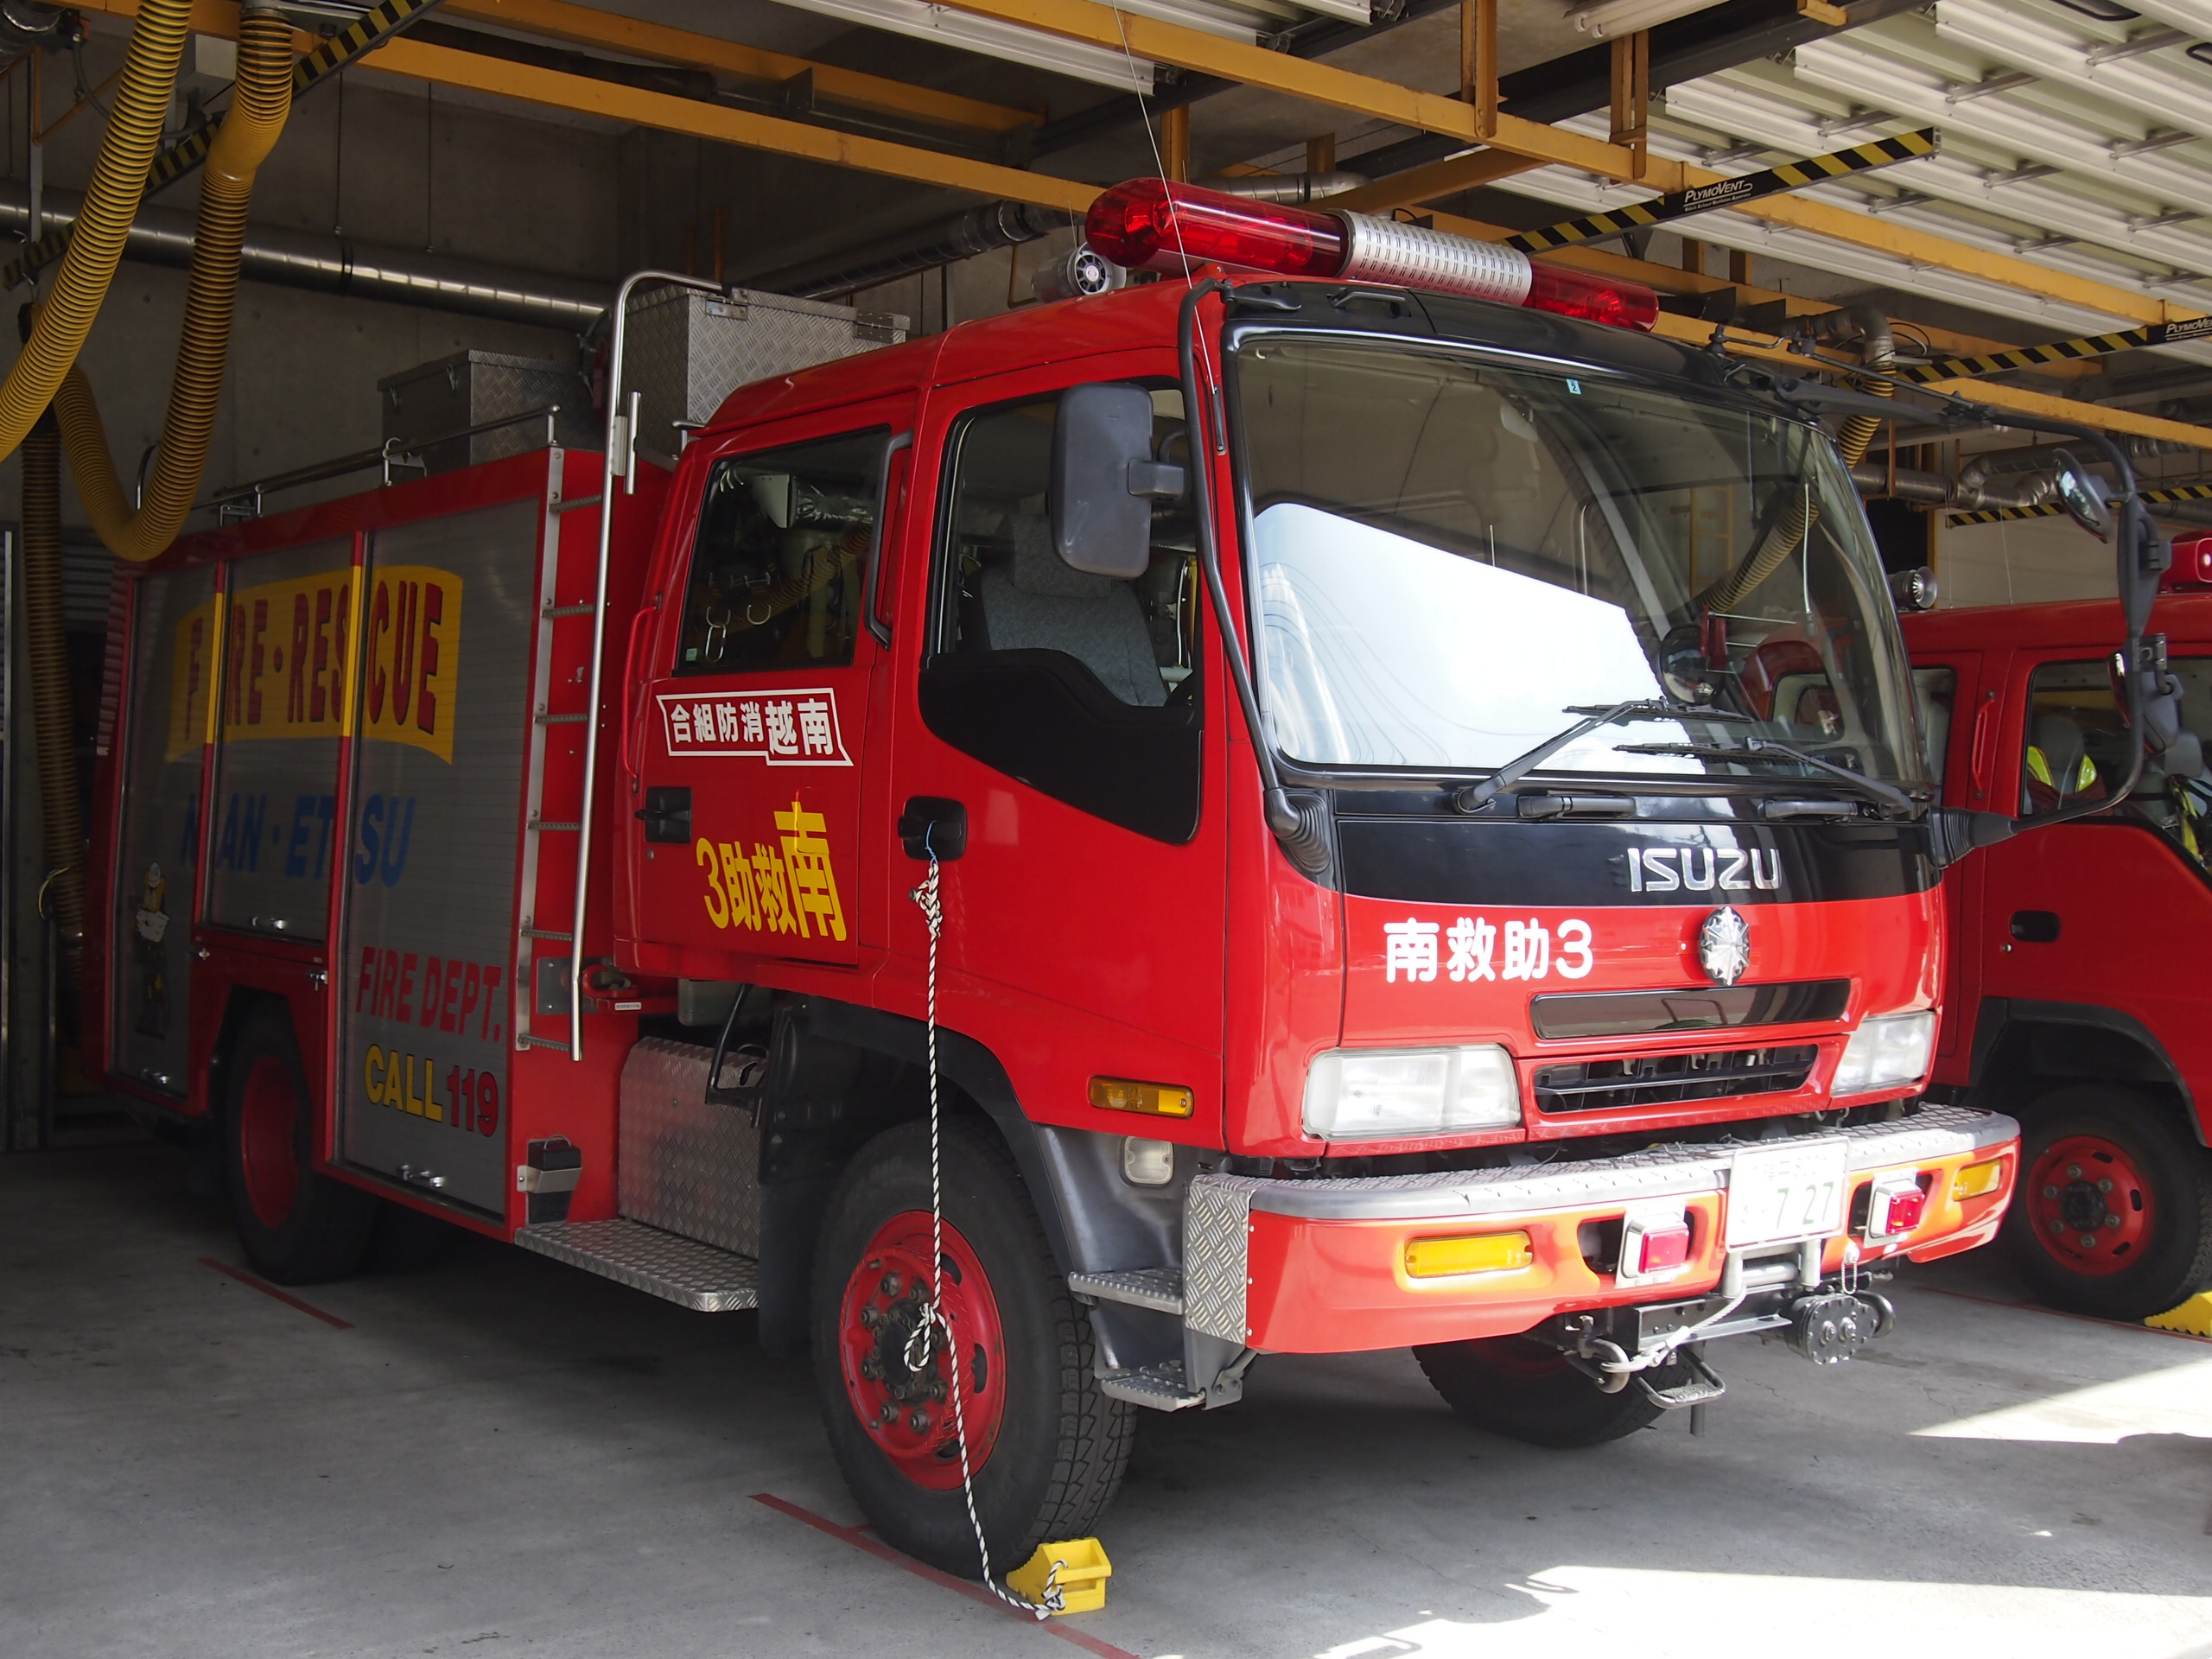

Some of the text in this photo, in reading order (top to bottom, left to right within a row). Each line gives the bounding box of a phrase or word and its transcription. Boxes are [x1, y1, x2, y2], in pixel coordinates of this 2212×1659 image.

[2166, 318, 2212, 334] PLYMOVE
[1628, 848, 1782, 893] ISUZU
[1383, 917, 1593, 983] 南救助3
[356, 945, 502, 1044] FIRE DEPT.
[365, 1043, 499, 1137] CALL 119
